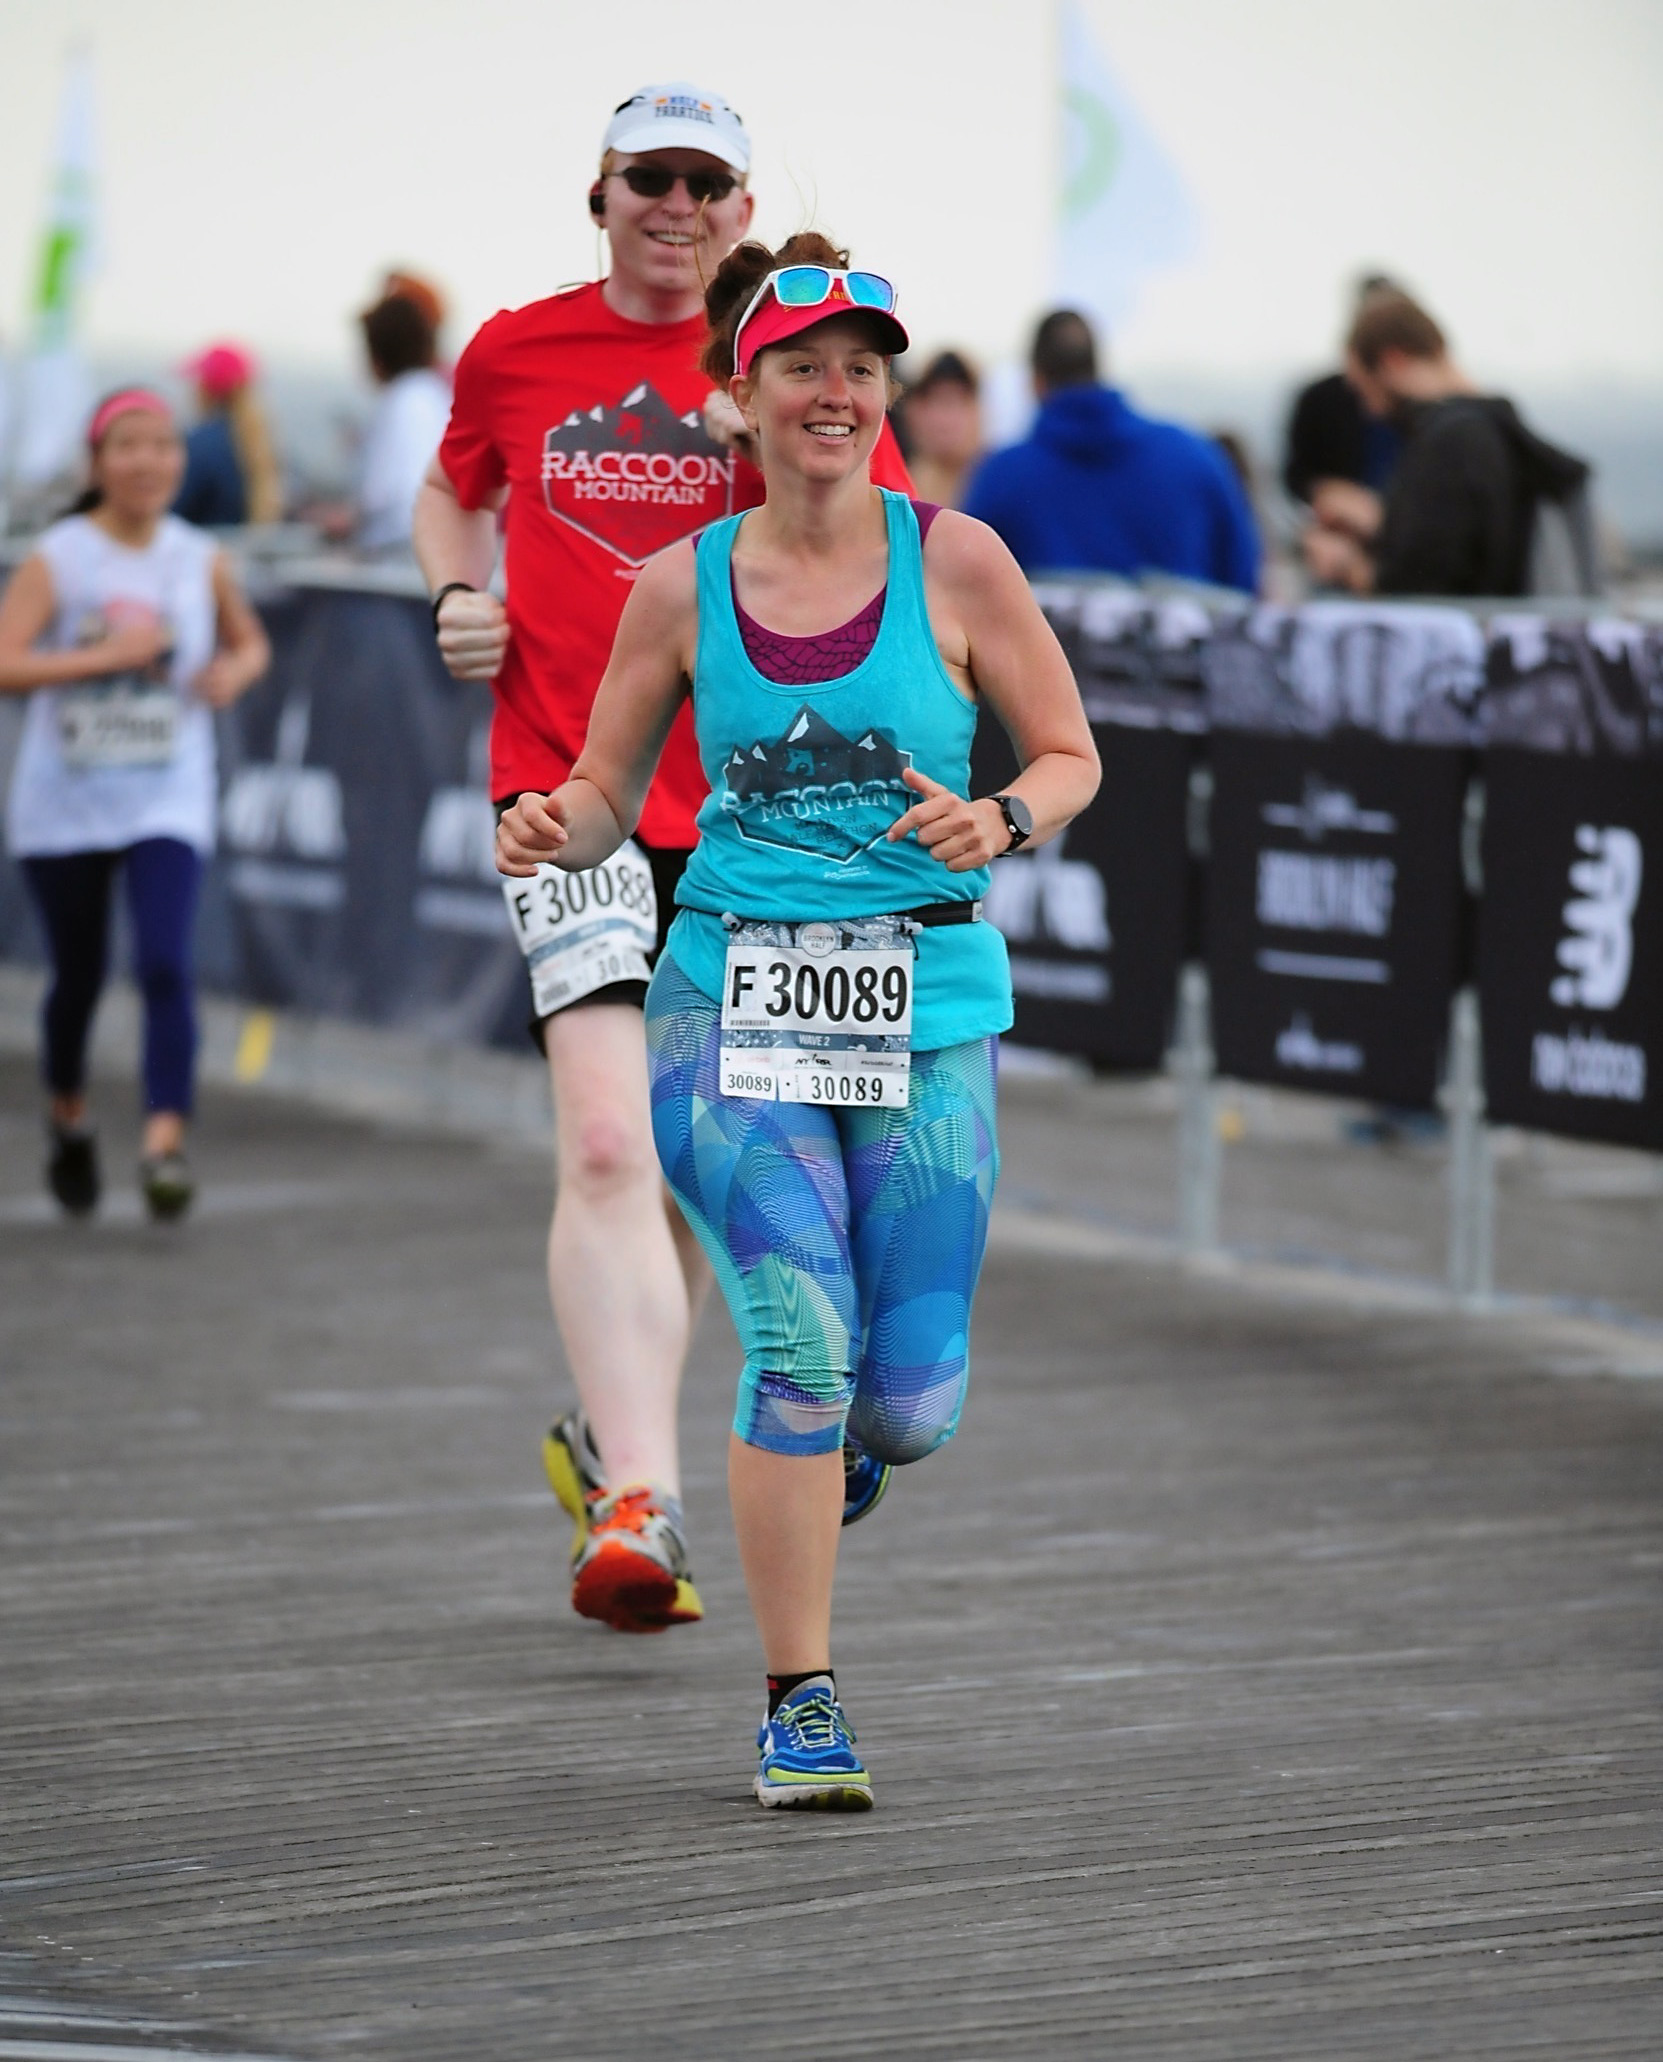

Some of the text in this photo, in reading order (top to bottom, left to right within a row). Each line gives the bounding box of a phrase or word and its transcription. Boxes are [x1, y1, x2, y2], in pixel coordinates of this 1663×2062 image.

[541, 451, 736, 485] RACCOON
[574, 480, 706, 505] MOUNTAIN
[731, 965, 757, 1008] F
[765, 962, 908, 1023] 30089
[799, 1034, 831, 1047] WAVE 2
[727, 1073, 773, 1093] 30089
[811, 1075, 884, 1103] 30089
